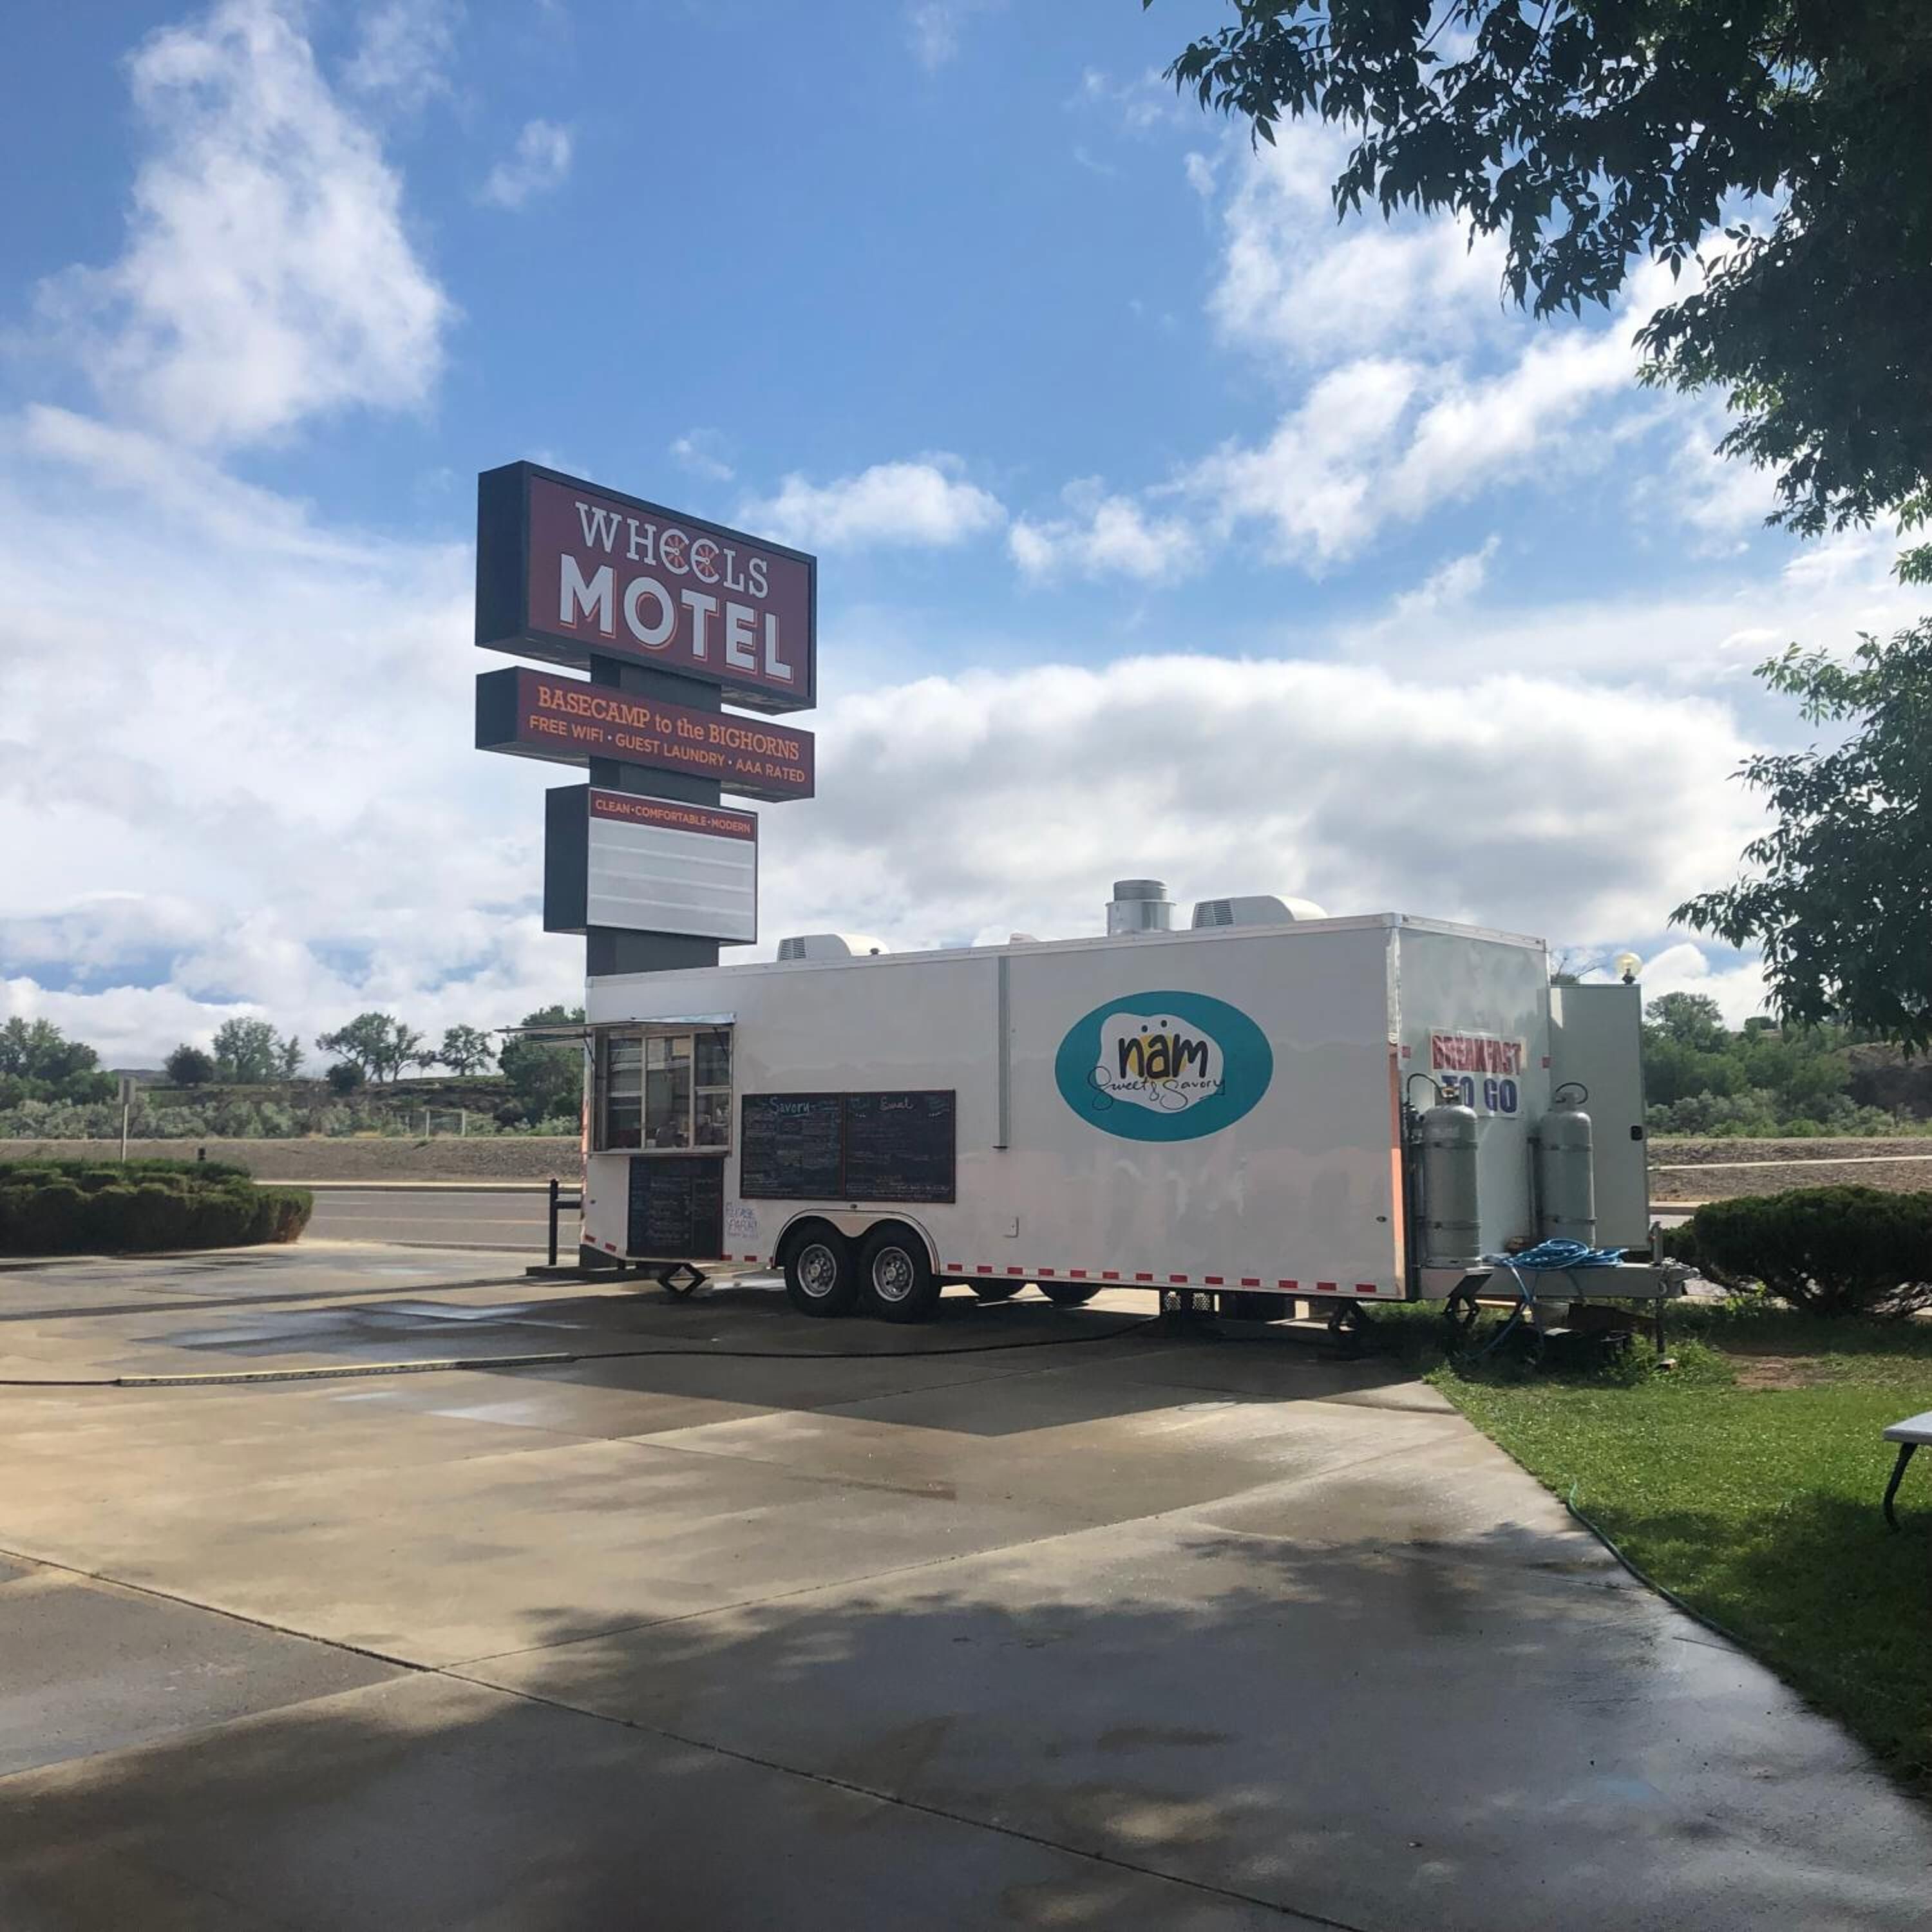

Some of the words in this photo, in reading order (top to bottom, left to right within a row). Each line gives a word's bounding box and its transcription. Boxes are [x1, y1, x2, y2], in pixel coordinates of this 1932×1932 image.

[575, 501, 769, 598] WHEELS
[560, 553, 793, 683] MOTEL
[529, 715, 567, 736] FREE
[571, 723, 604, 743] WIFI
[616, 734, 661, 753] GUEST
[664, 744, 726, 766] LAUNDRY
[735, 759, 763, 775] AAA
[765, 763, 805, 782] RATED
[538, 686, 650, 728] BASECAMP
[654, 713, 672, 734] to
[677, 717, 704, 740] the
[708, 723, 799, 761] BIGHORNS
[596, 799, 631, 813] CLEAN
[635, 806, 707, 827] COMFORTABLE
[710, 819, 751, 833] MODERN
[1432, 1035, 1522, 1075] BREAKFAST
[1087, 1065, 1149, 1111] Sweet
[1160, 1079, 1226, 1110] Savory
[1483, 1078, 1518, 1113] GO
